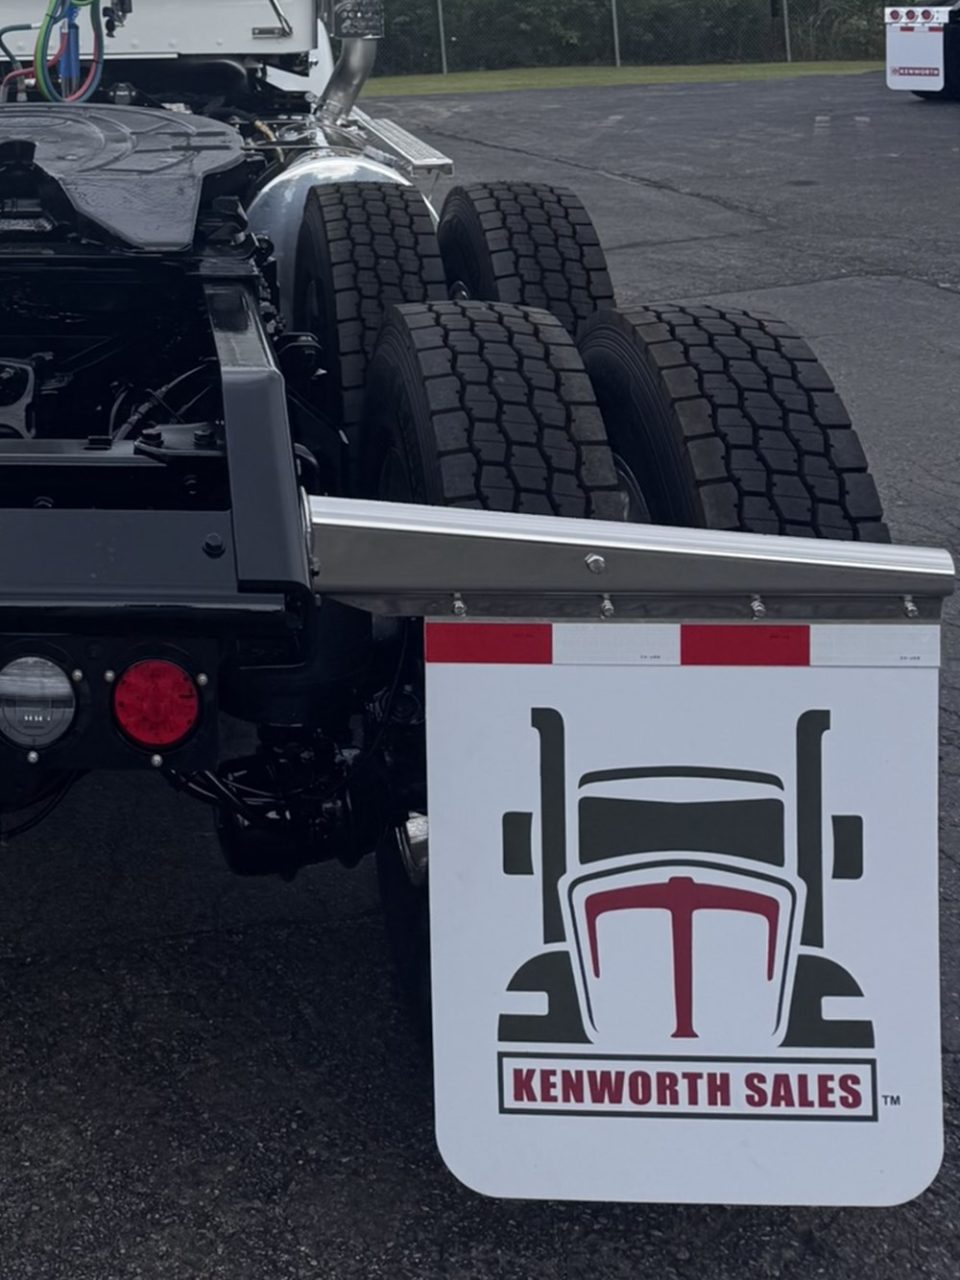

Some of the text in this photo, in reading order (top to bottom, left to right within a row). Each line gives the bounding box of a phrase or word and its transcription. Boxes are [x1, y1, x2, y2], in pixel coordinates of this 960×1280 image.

[512, 1068, 863, 1109] KENWORTH SALES
[881, 1094, 901, 1106] TM
